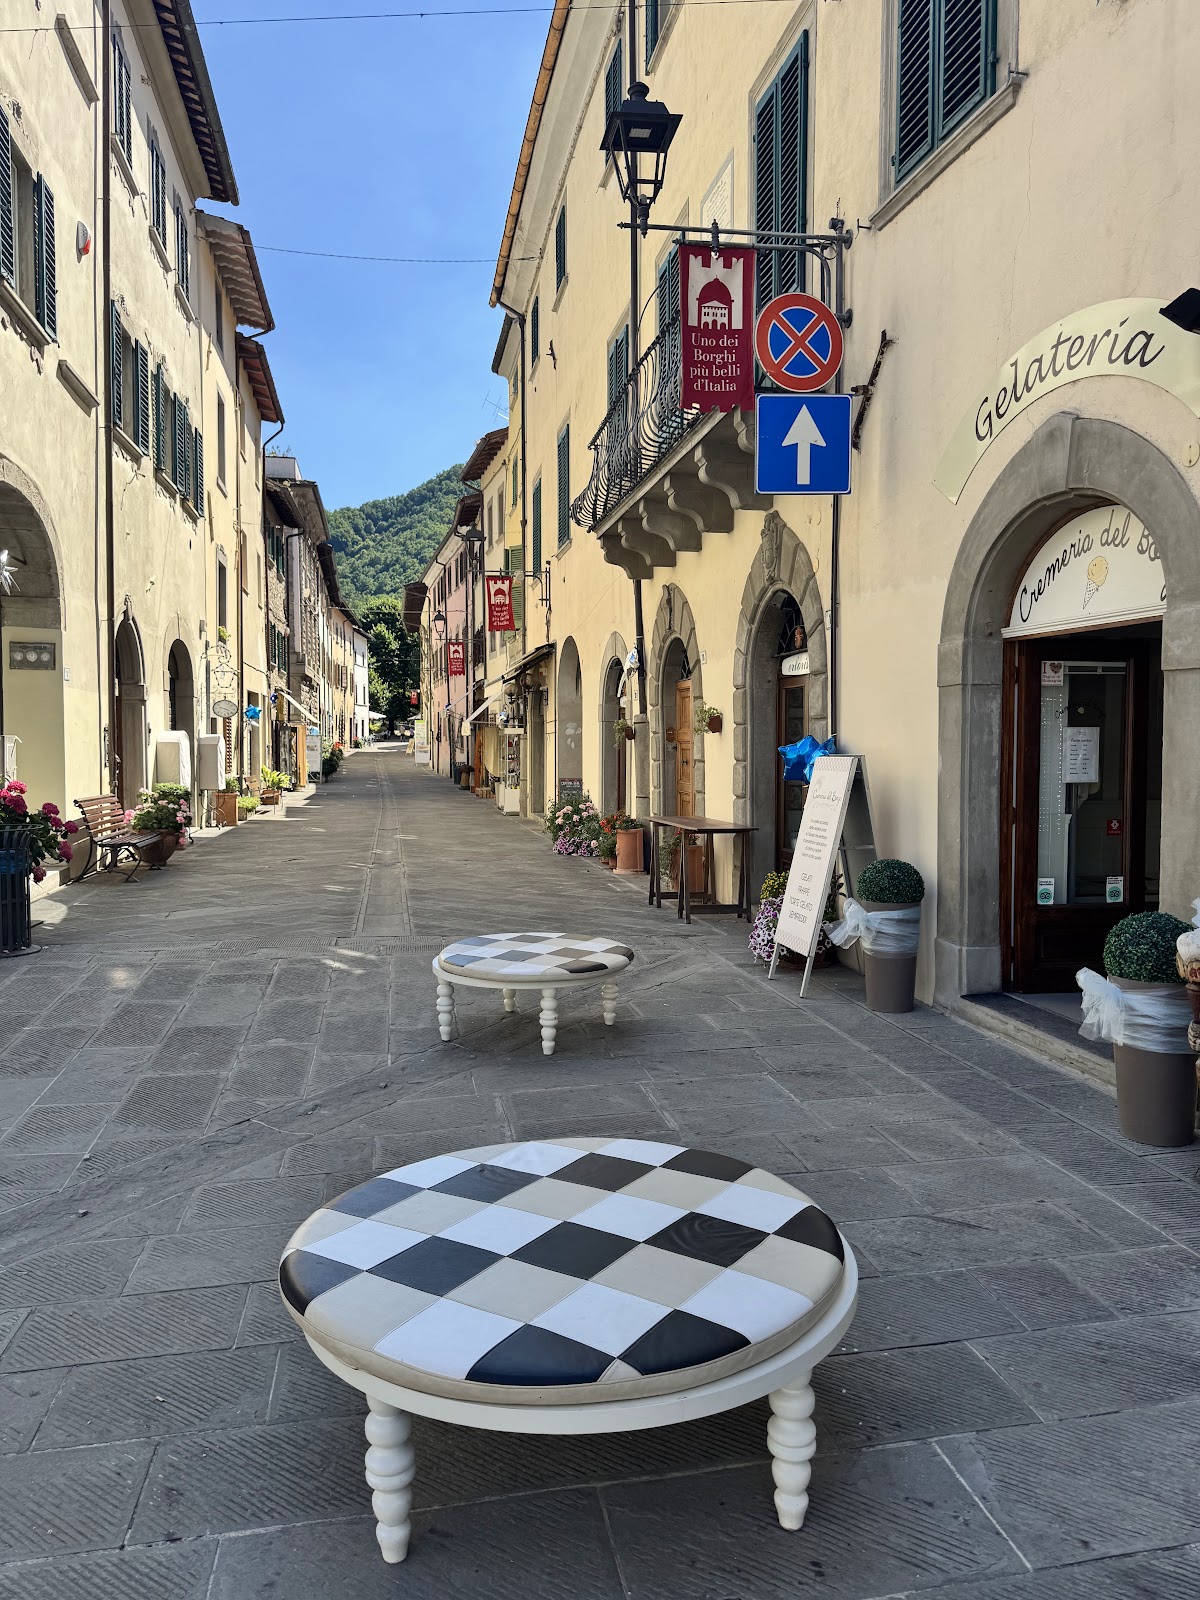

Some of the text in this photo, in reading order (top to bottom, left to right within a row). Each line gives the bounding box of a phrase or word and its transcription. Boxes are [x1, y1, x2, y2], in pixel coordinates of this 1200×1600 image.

[691, 332, 739, 347] Uno dei
[694, 348, 736, 365] Borghi
[690, 363, 740, 378] più belli
[693, 379, 737, 392] d'Italia
[975, 316, 1166, 442] Gelateria
[1019, 529, 1094, 623] Cremeria
[1100, 508, 1131, 548] del
